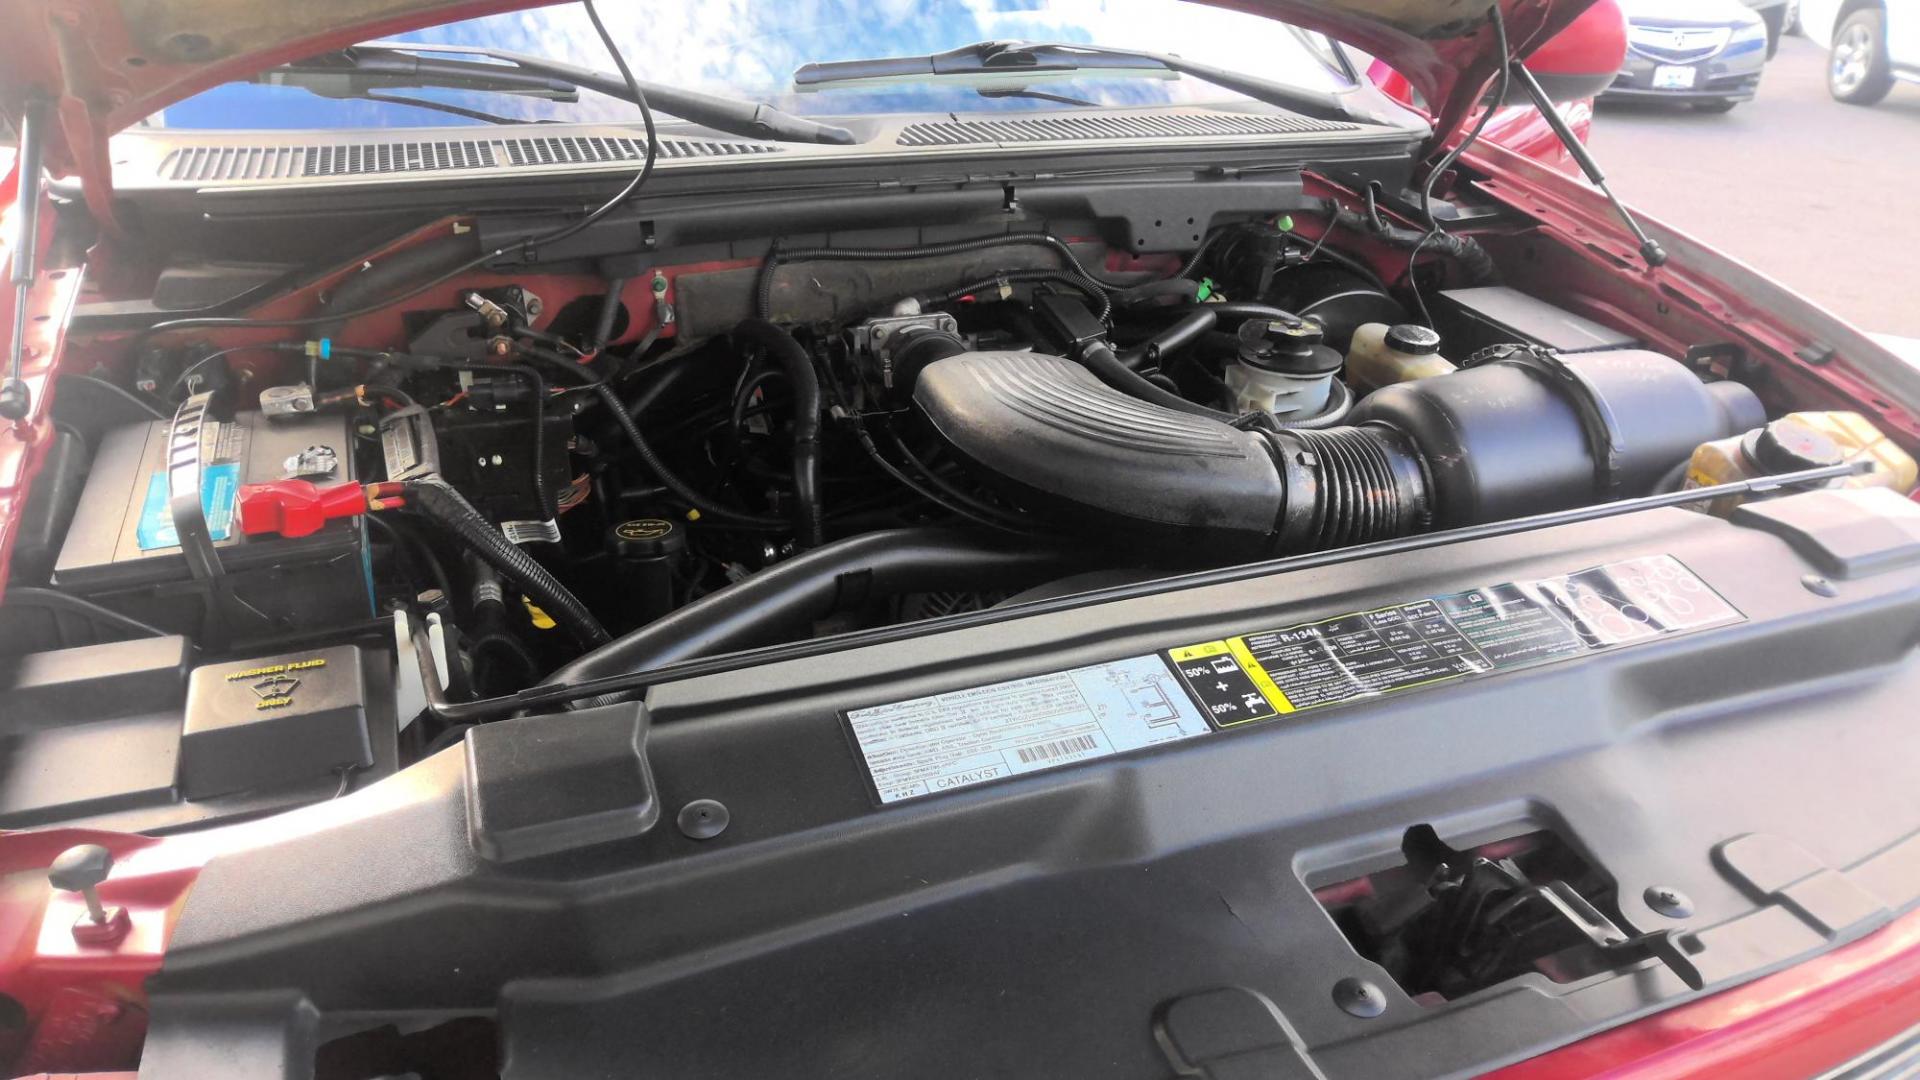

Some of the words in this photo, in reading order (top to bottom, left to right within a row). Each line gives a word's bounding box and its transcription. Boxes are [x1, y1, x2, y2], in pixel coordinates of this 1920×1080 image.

[1280, 627, 1321, 642] R-134A
[224, 665, 284, 682] WASHER
[287, 658, 327, 671] FLUID
[1185, 666, 1211, 678] 50%
[256, 697, 292, 709] ONLY
[1211, 702, 1237, 714] 50%
[936, 767, 999, 788] CATALYST
